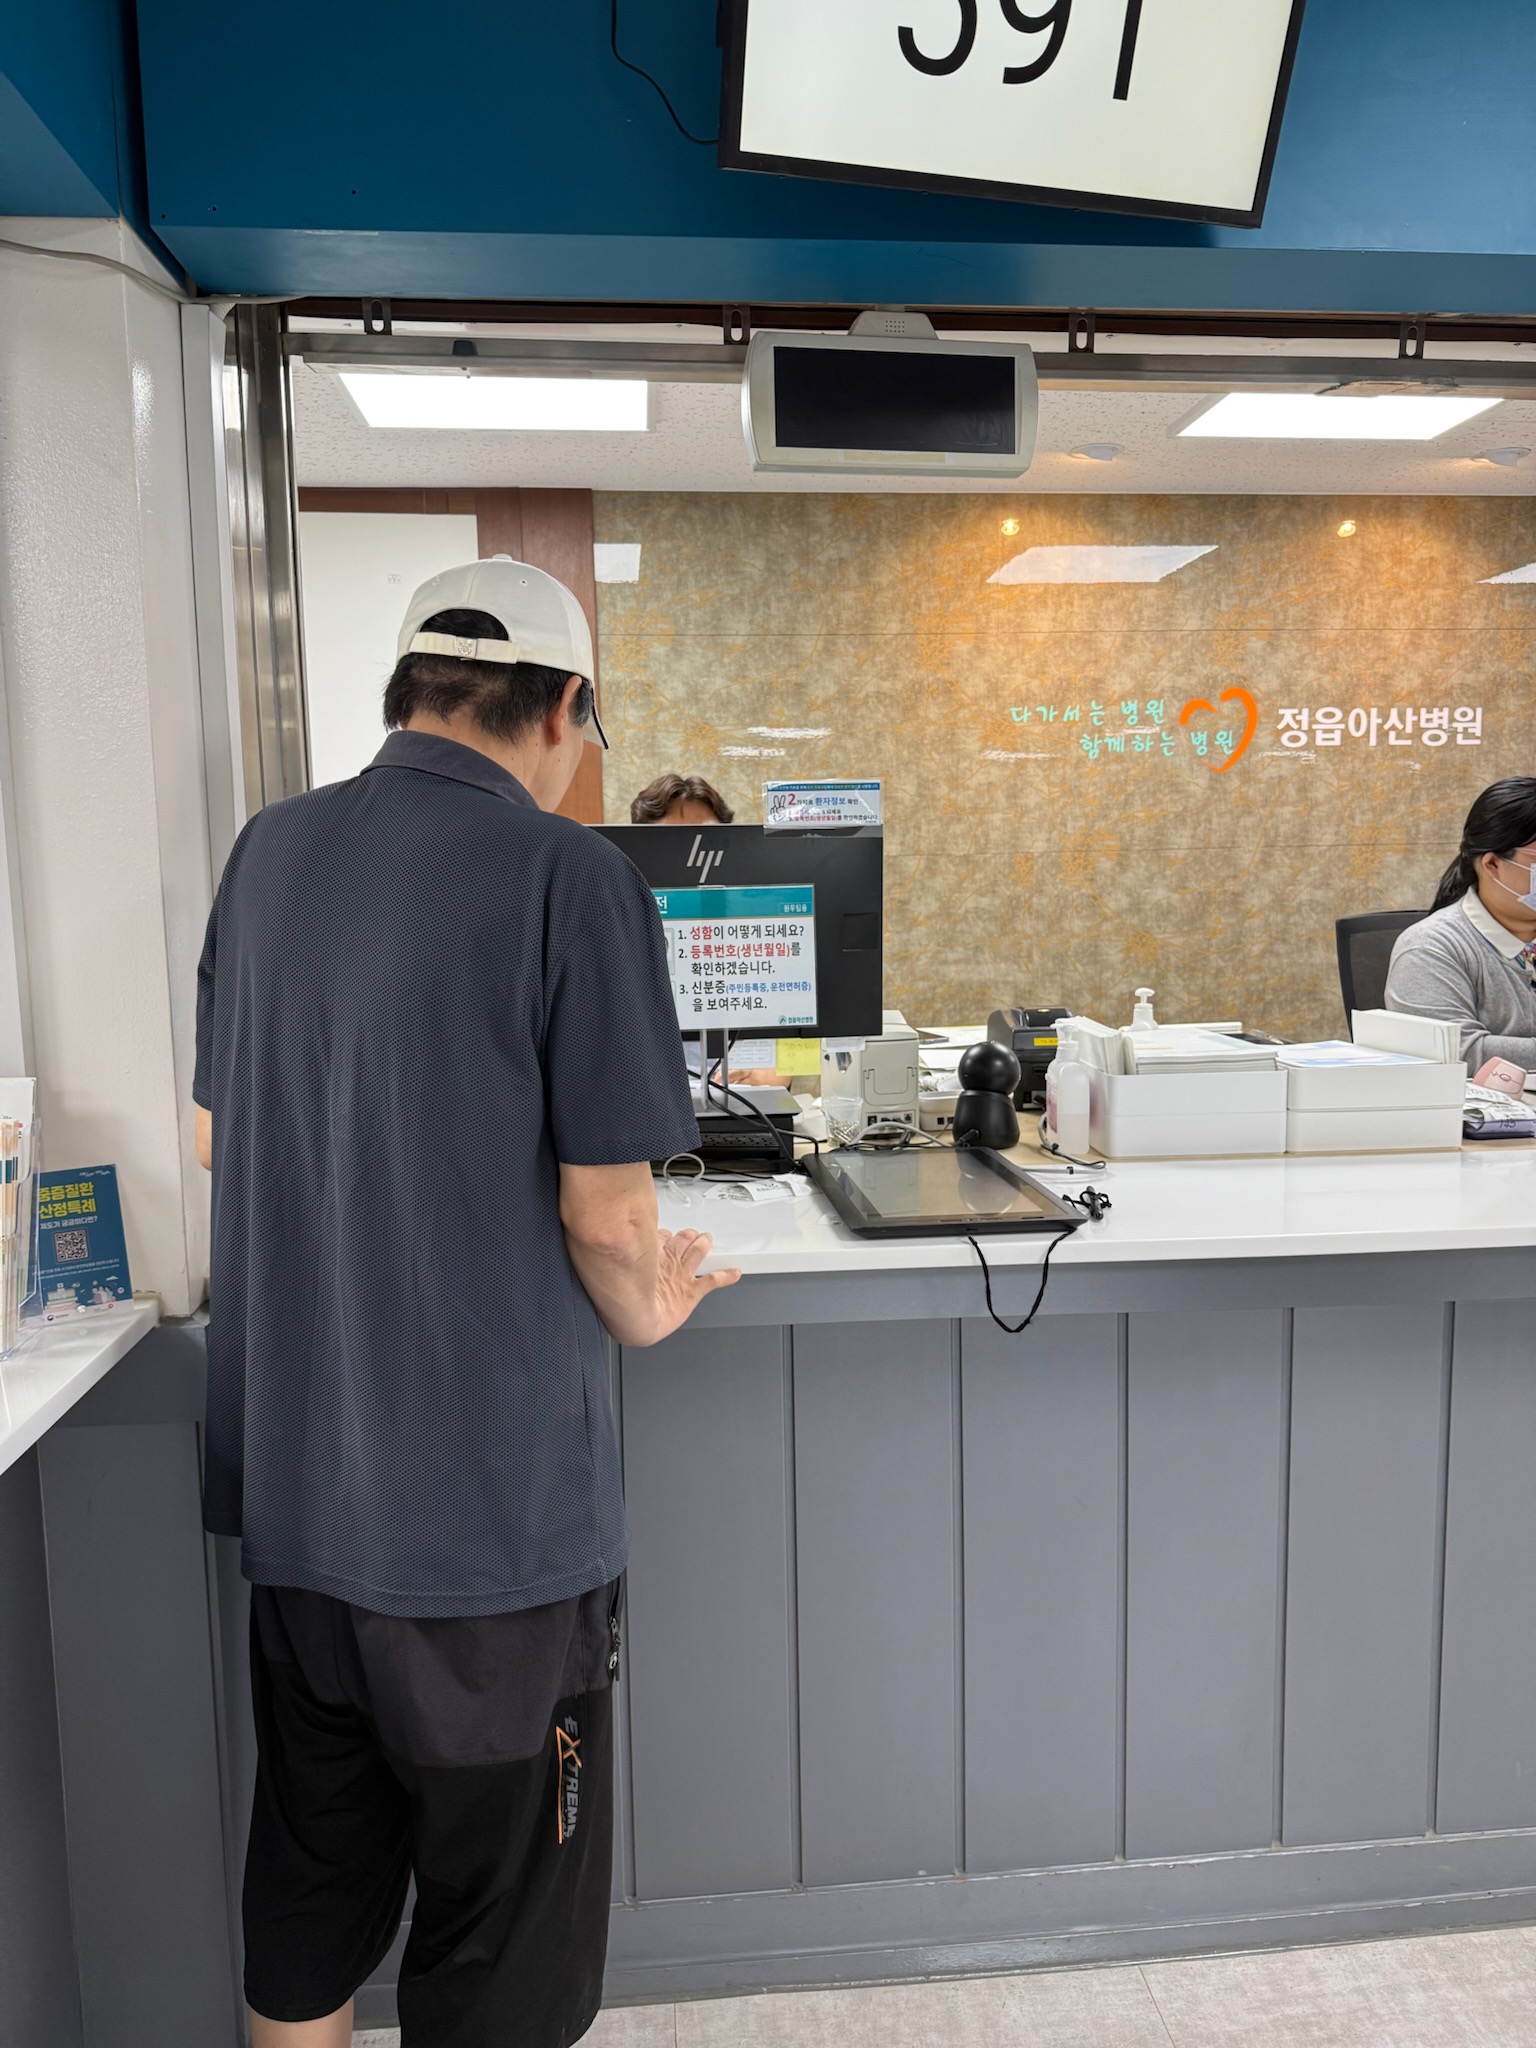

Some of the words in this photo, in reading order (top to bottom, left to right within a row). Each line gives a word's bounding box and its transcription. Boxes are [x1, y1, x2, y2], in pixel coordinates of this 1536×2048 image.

[1009, 700, 1106, 724] 다가서는
[1120, 699, 1166, 723] 병원
[1276, 705, 1484, 749] 정읍아산병원
[1079, 730, 1175, 760] 함께하는
[1190, 729, 1233, 756] 병원
[815, 797, 846, 806] 환자정보
[686, 834, 724, 884] hp
[678, 930, 687, 940] 1.
[690, 925, 724, 941] 성함이
[728, 924, 762, 940] 어떻게
[764, 923, 804, 939] 되세요?
[678, 949, 687, 959] 2.
[690, 942, 801, 960] 등록번호(생년월일)를
[691, 961, 775, 976] 확인하겠습니다.
[679, 985, 689, 995] 3.
[771, 981, 811, 993] 운전면허증)
[692, 998, 704, 1013] 을
[707, 996, 768, 1012] 보여주세요.
[39, 1198, 96, 1220] 산정특례
